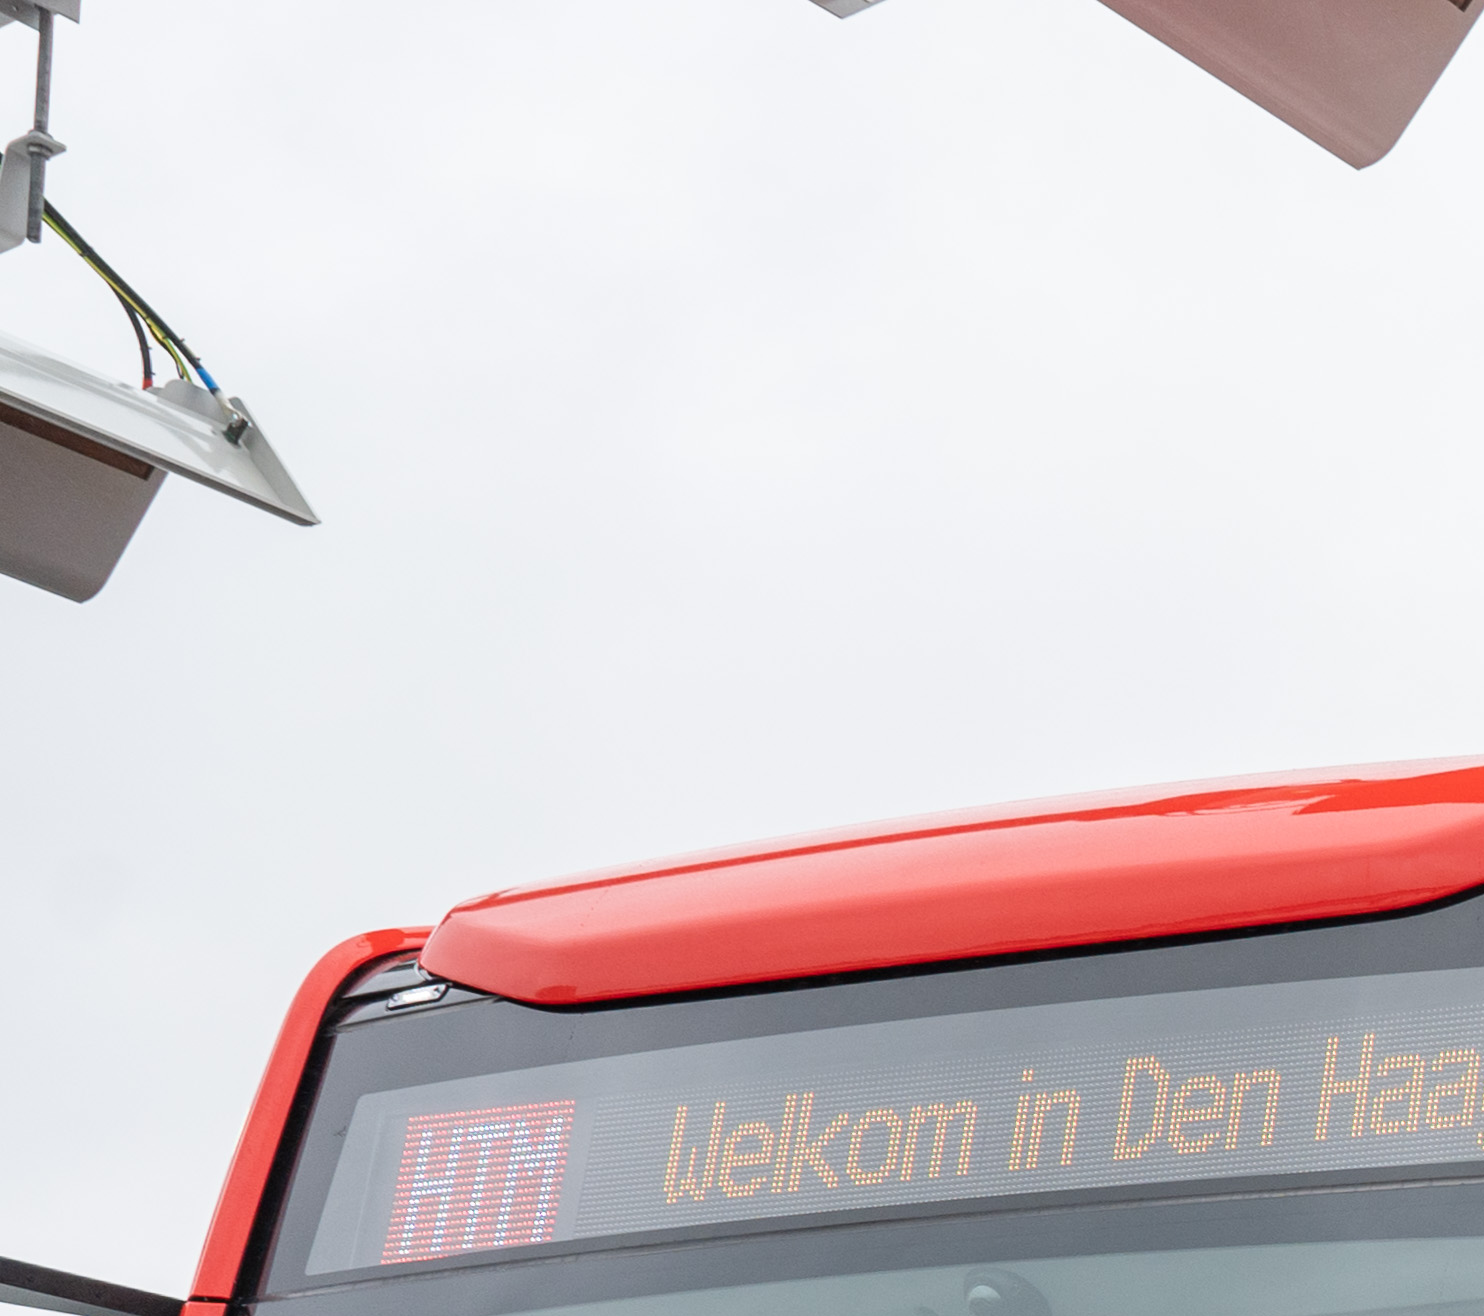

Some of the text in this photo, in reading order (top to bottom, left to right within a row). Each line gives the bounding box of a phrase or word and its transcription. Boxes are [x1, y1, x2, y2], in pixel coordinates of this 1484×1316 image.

[399, 1114, 565, 1255] HTM
[662, 1086, 975, 1206] Welkom
[1006, 1068, 1078, 1170] in
[1112, 1054, 1282, 1162] Den
